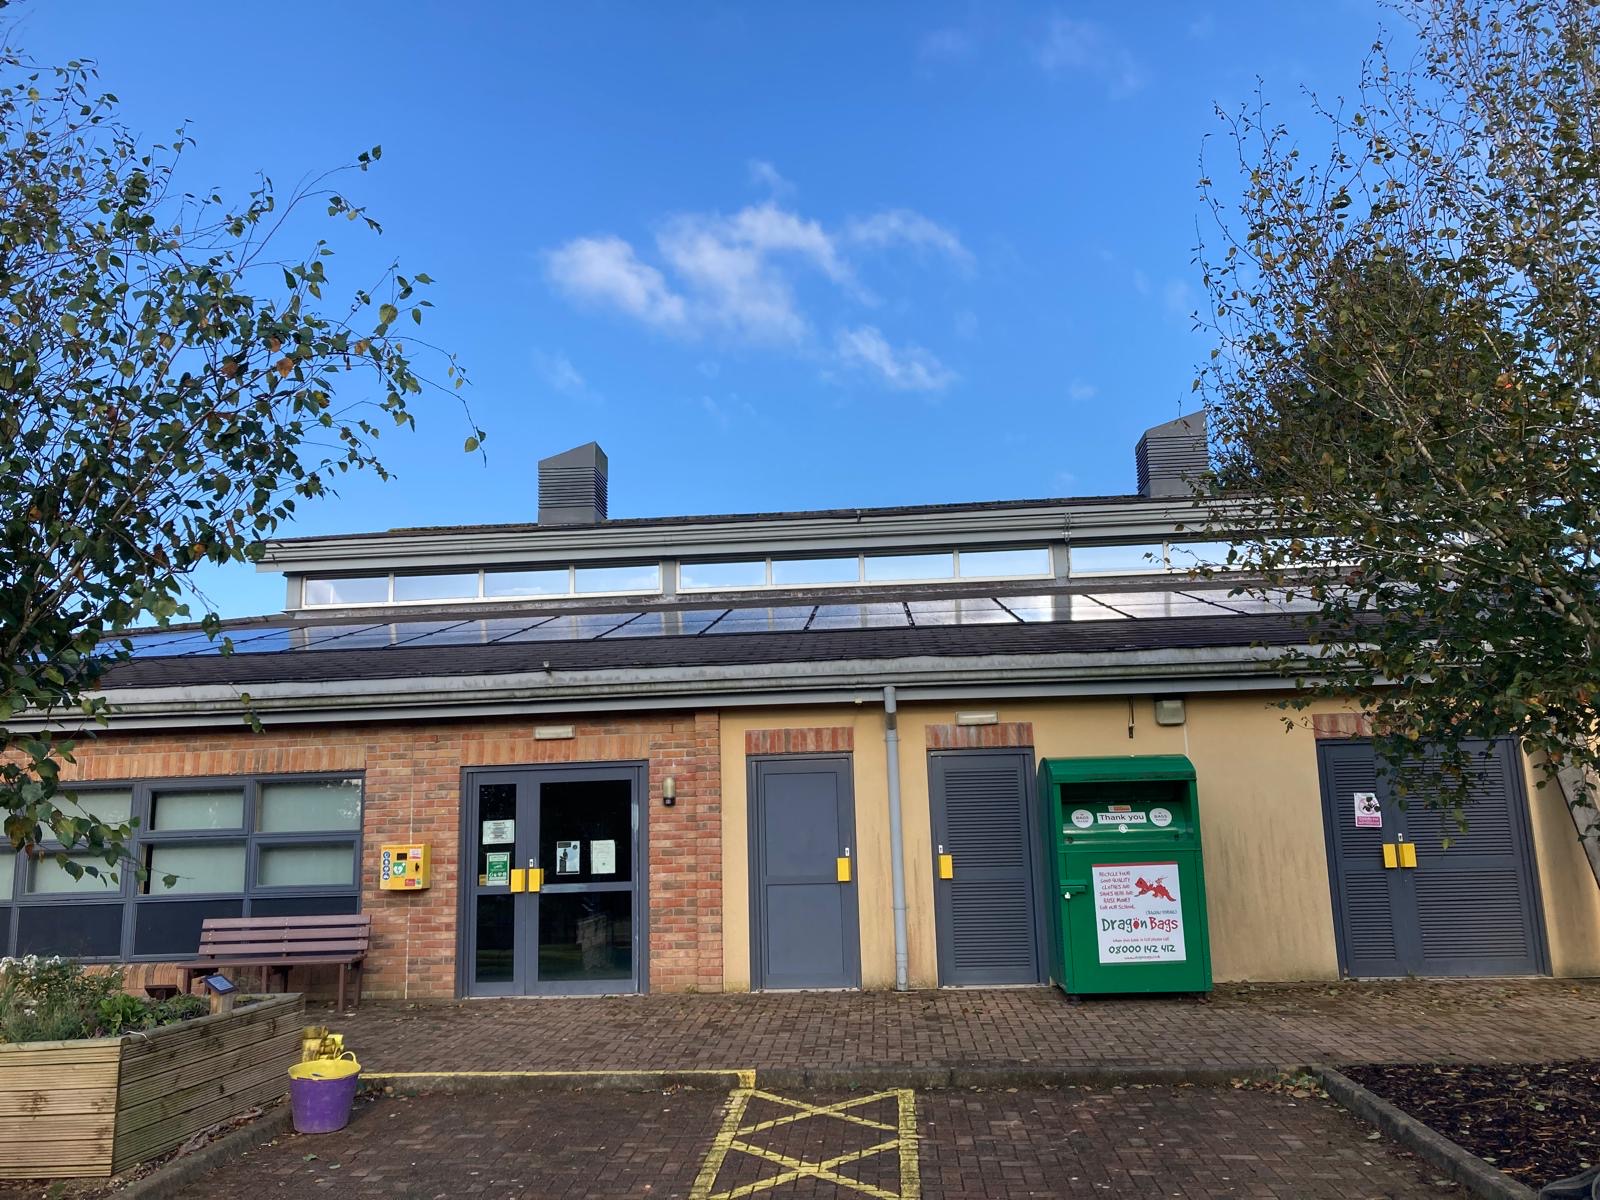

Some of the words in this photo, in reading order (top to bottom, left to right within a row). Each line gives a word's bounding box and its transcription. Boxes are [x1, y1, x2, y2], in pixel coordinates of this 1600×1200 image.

[1128, 813, 1145, 821] you
[1101, 917, 1147, 933] Dragon
[1148, 916, 1179, 933] Bags
[1108, 945, 1142, 954] 08000
[1144, 944, 1159, 953] 142
[1161, 944, 1176, 953] 412
